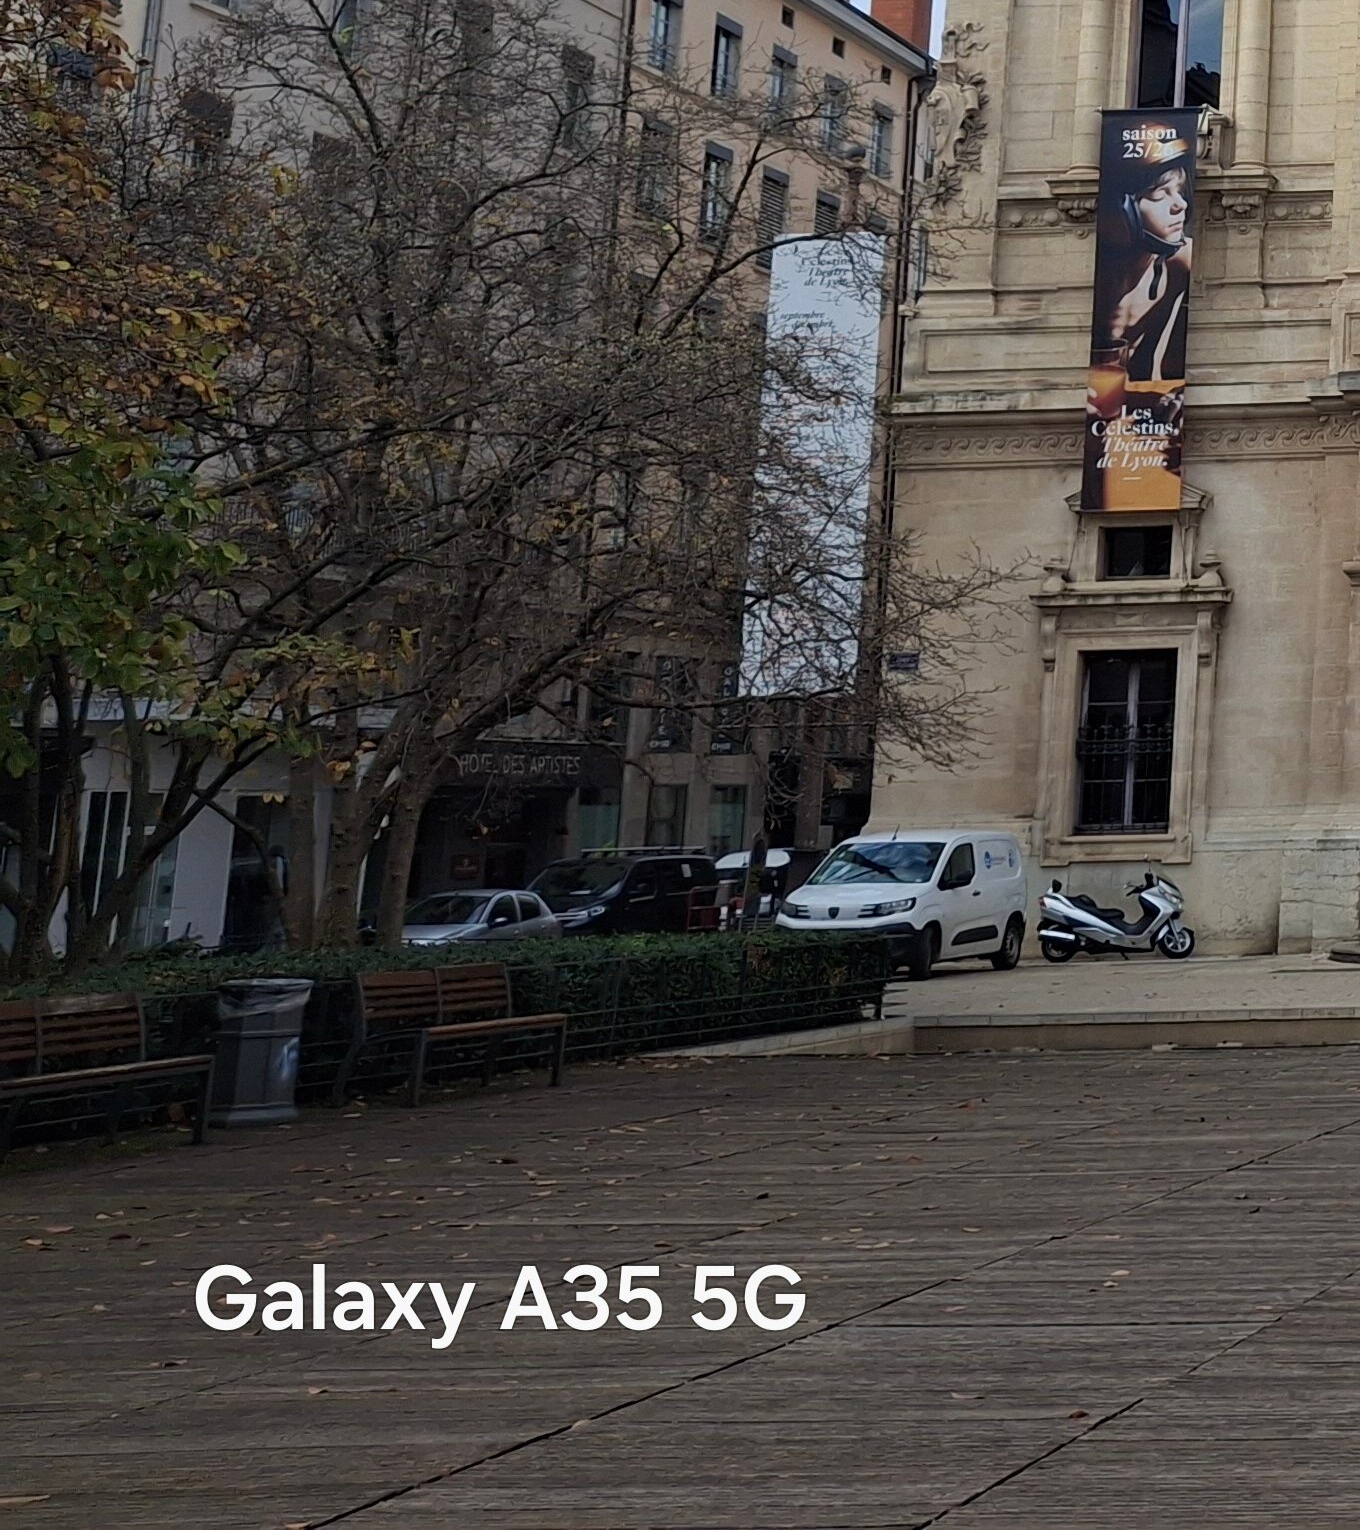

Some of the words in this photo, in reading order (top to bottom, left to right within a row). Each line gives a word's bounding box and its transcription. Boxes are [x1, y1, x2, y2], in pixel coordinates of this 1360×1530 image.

[1122, 124, 1177, 141] saison
[1121, 404, 1152, 420] Les
[1096, 453, 1118, 469] de
[1121, 452, 1169, 472] Lyon.
[503, 755, 526, 774] DES
[530, 756, 582, 775] ARTISTES
